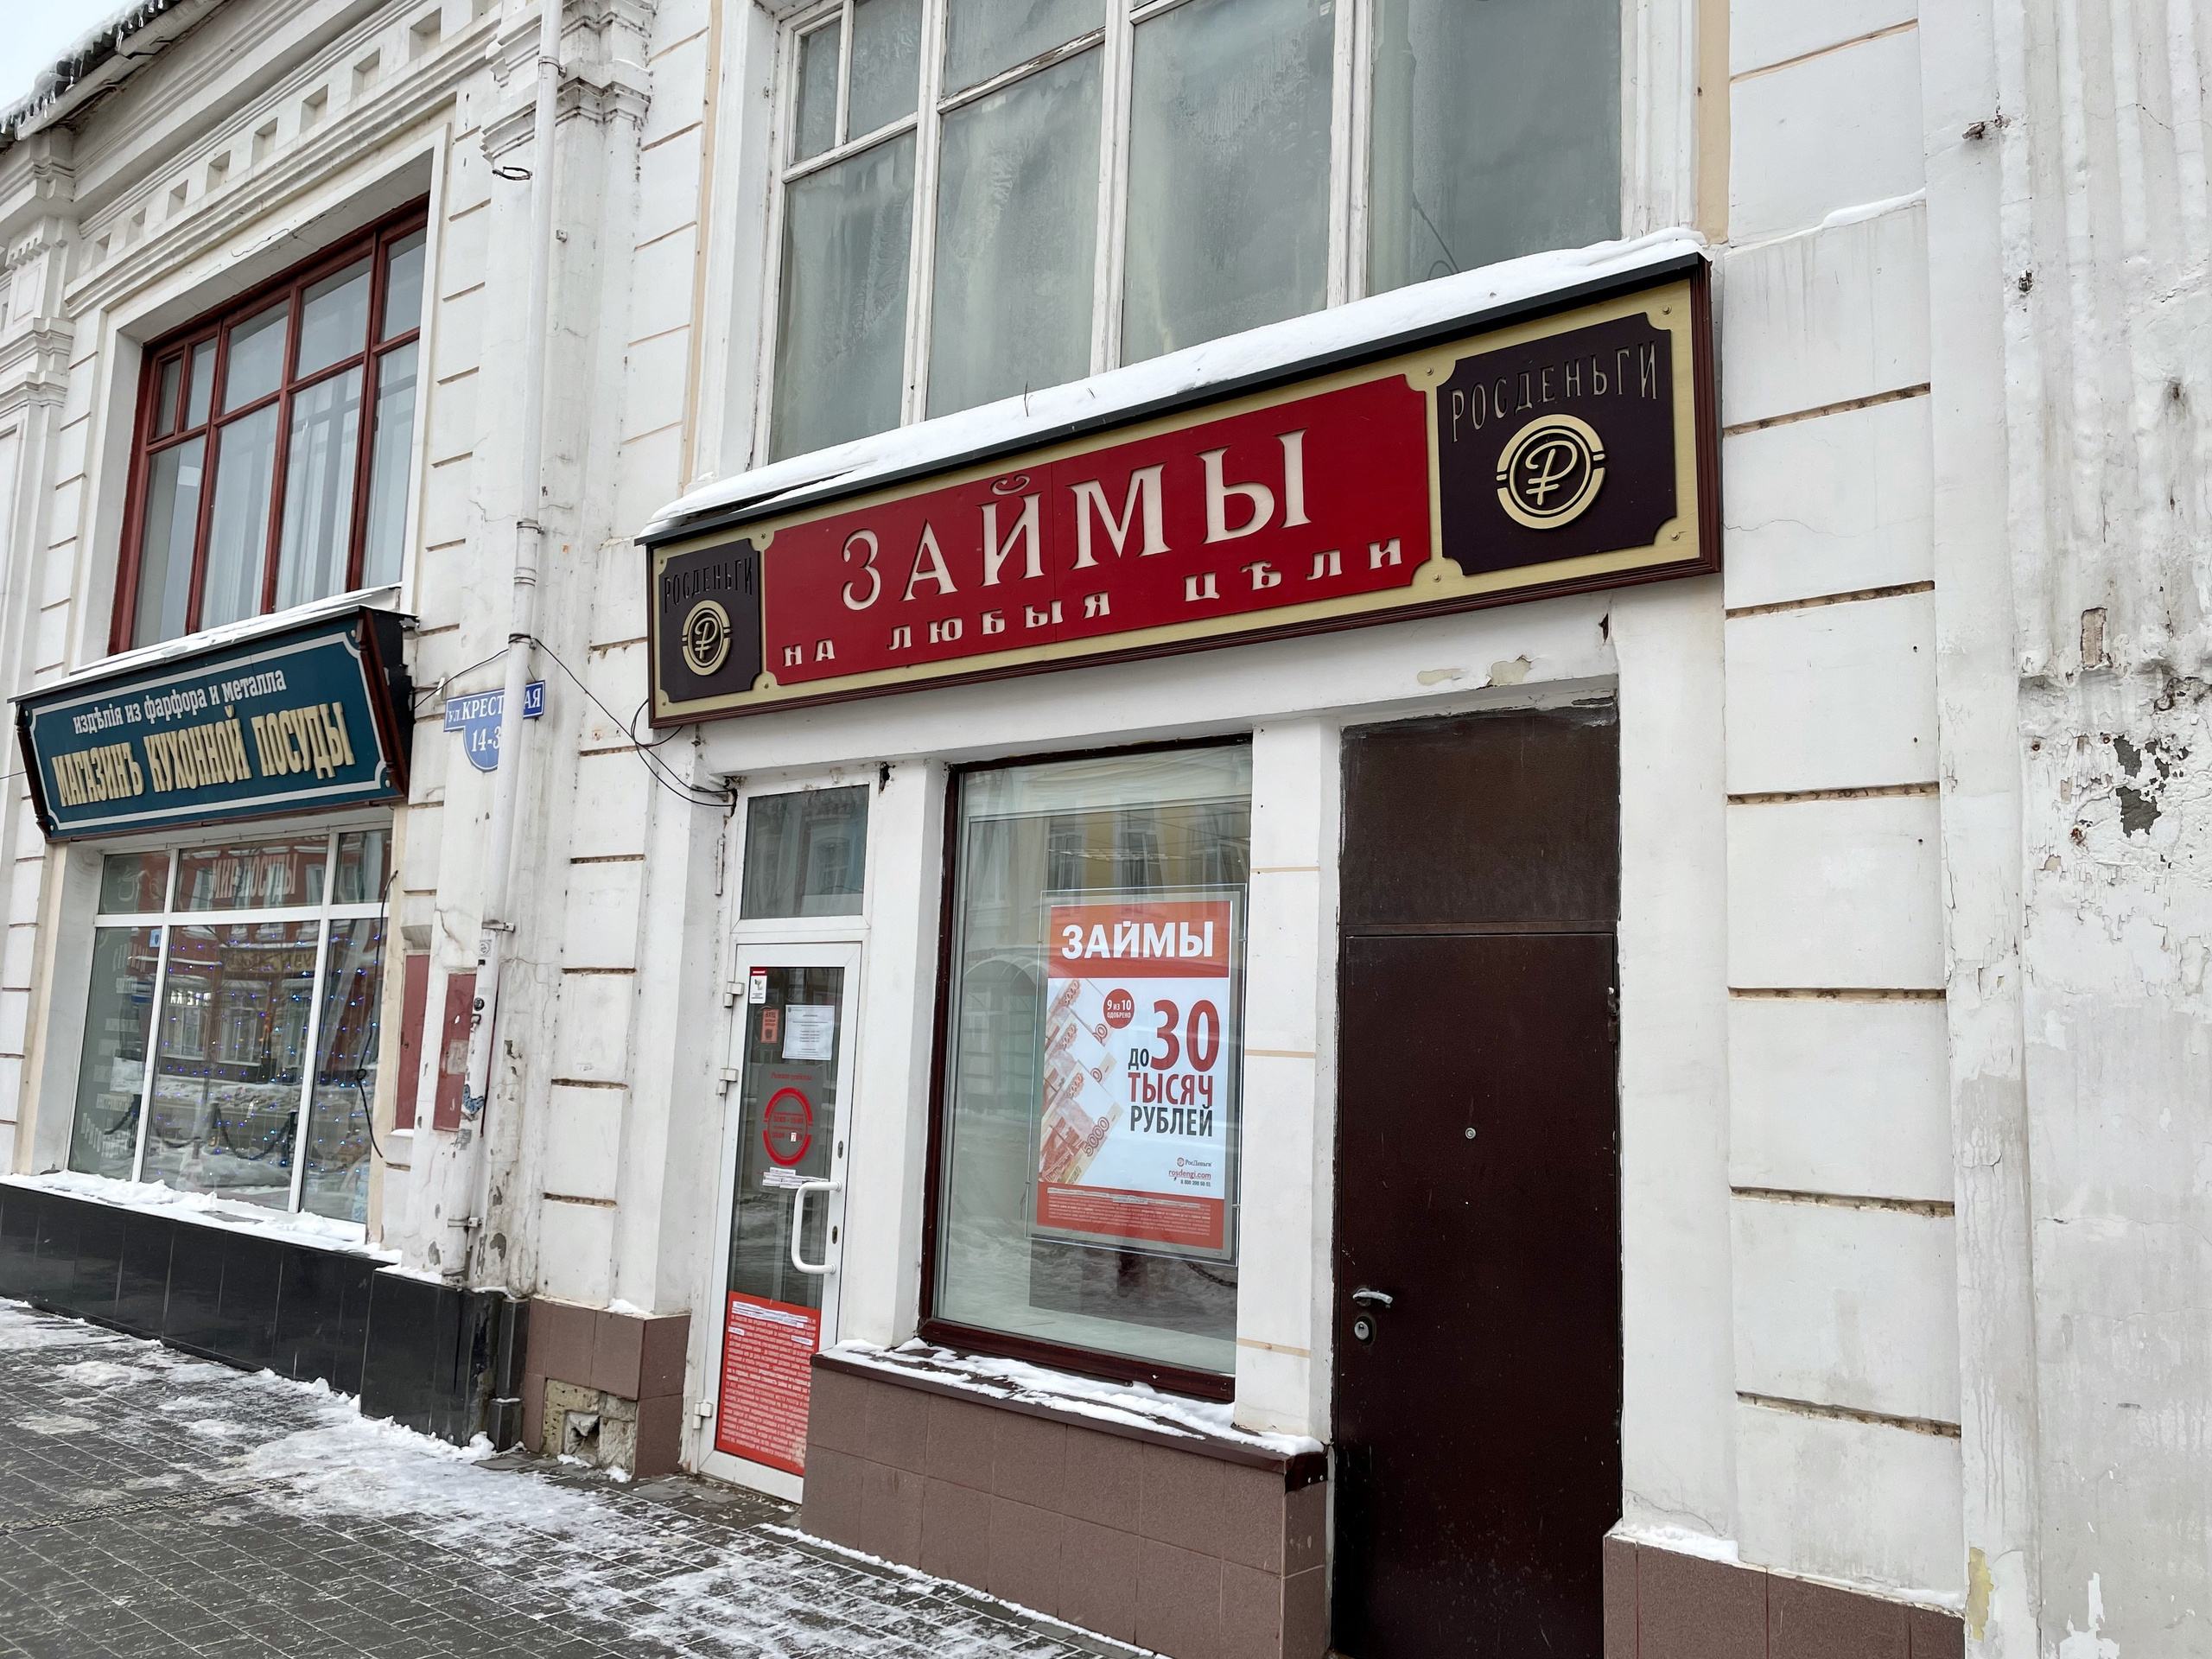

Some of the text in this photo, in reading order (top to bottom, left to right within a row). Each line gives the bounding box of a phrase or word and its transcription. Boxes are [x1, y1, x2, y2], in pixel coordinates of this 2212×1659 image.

[1449, 340, 1657, 443] РОСДЕНЬГИ
[841, 427, 1312, 611] ЗАЙМЫ
[664, 557, 753, 614] РОСДЕНЬГИ
[124, 702, 142, 723] из
[143, 689, 207, 724] фарфора
[208, 684, 220, 706] и
[221, 670, 287, 703] металла
[462, 687, 541, 721] КРЕСТАЯ
[51, 702, 356, 807] МАГАЗИНЪ КУХОННОЙ ПОСУДЫ
[1061, 921, 1214, 960] ЗАЙМЫ
[1107, 999, 1113, 1011] 9
[1122, 999, 1132, 1011] 10
[1150, 999, 1220, 1072] 30
[1128, 1072, 1214, 1107] ТЫСЯЧ
[1080, 1116, 1109, 1158] 5000
[1130, 1104, 1213, 1137] РУБЛЕЙ
[1168, 1169, 1211, 1179] rosdengi.com
